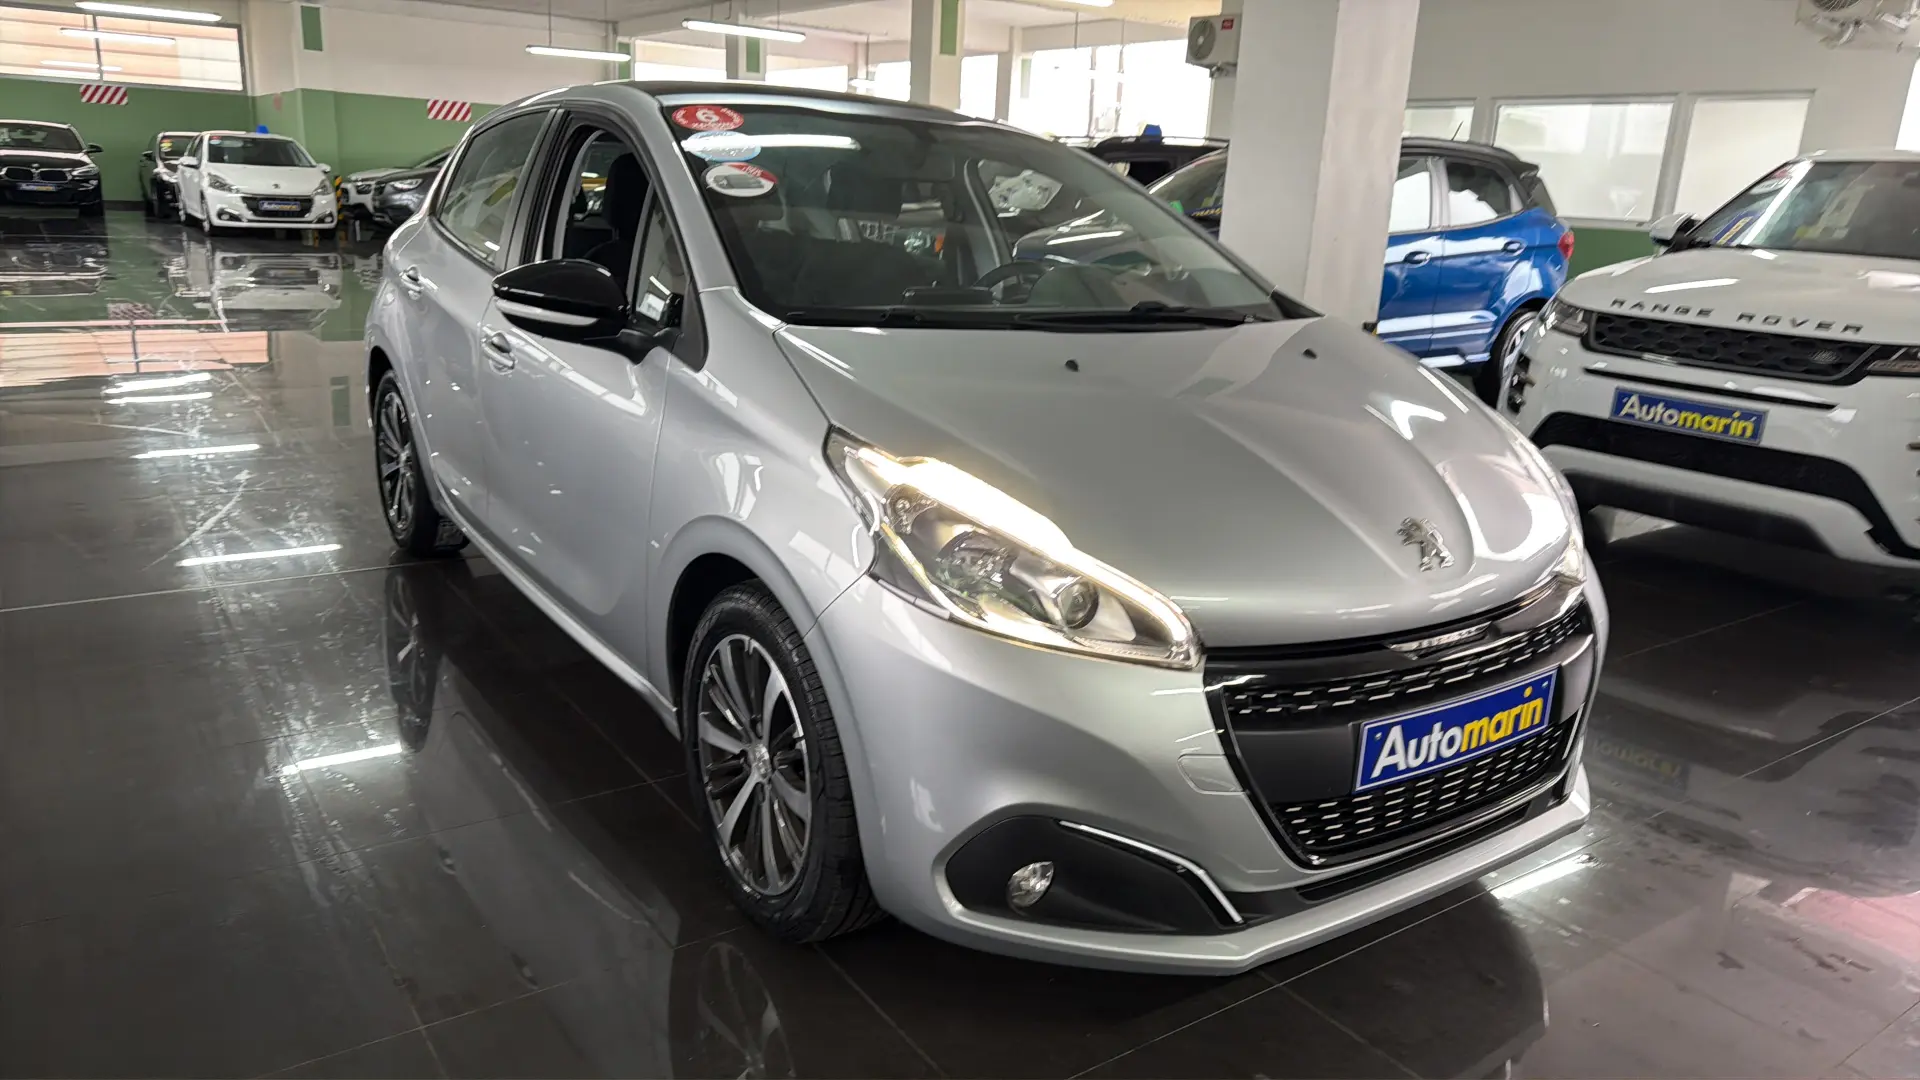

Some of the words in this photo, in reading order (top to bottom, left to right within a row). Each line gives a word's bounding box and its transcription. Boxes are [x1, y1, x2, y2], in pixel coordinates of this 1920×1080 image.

[695, 109, 720, 123] 6
[1610, 298, 1715, 318] RANGE
[1736, 311, 1865, 335] ROVER
[1618, 393, 1756, 438] Automarin
[1370, 685, 1544, 779] Automarin
